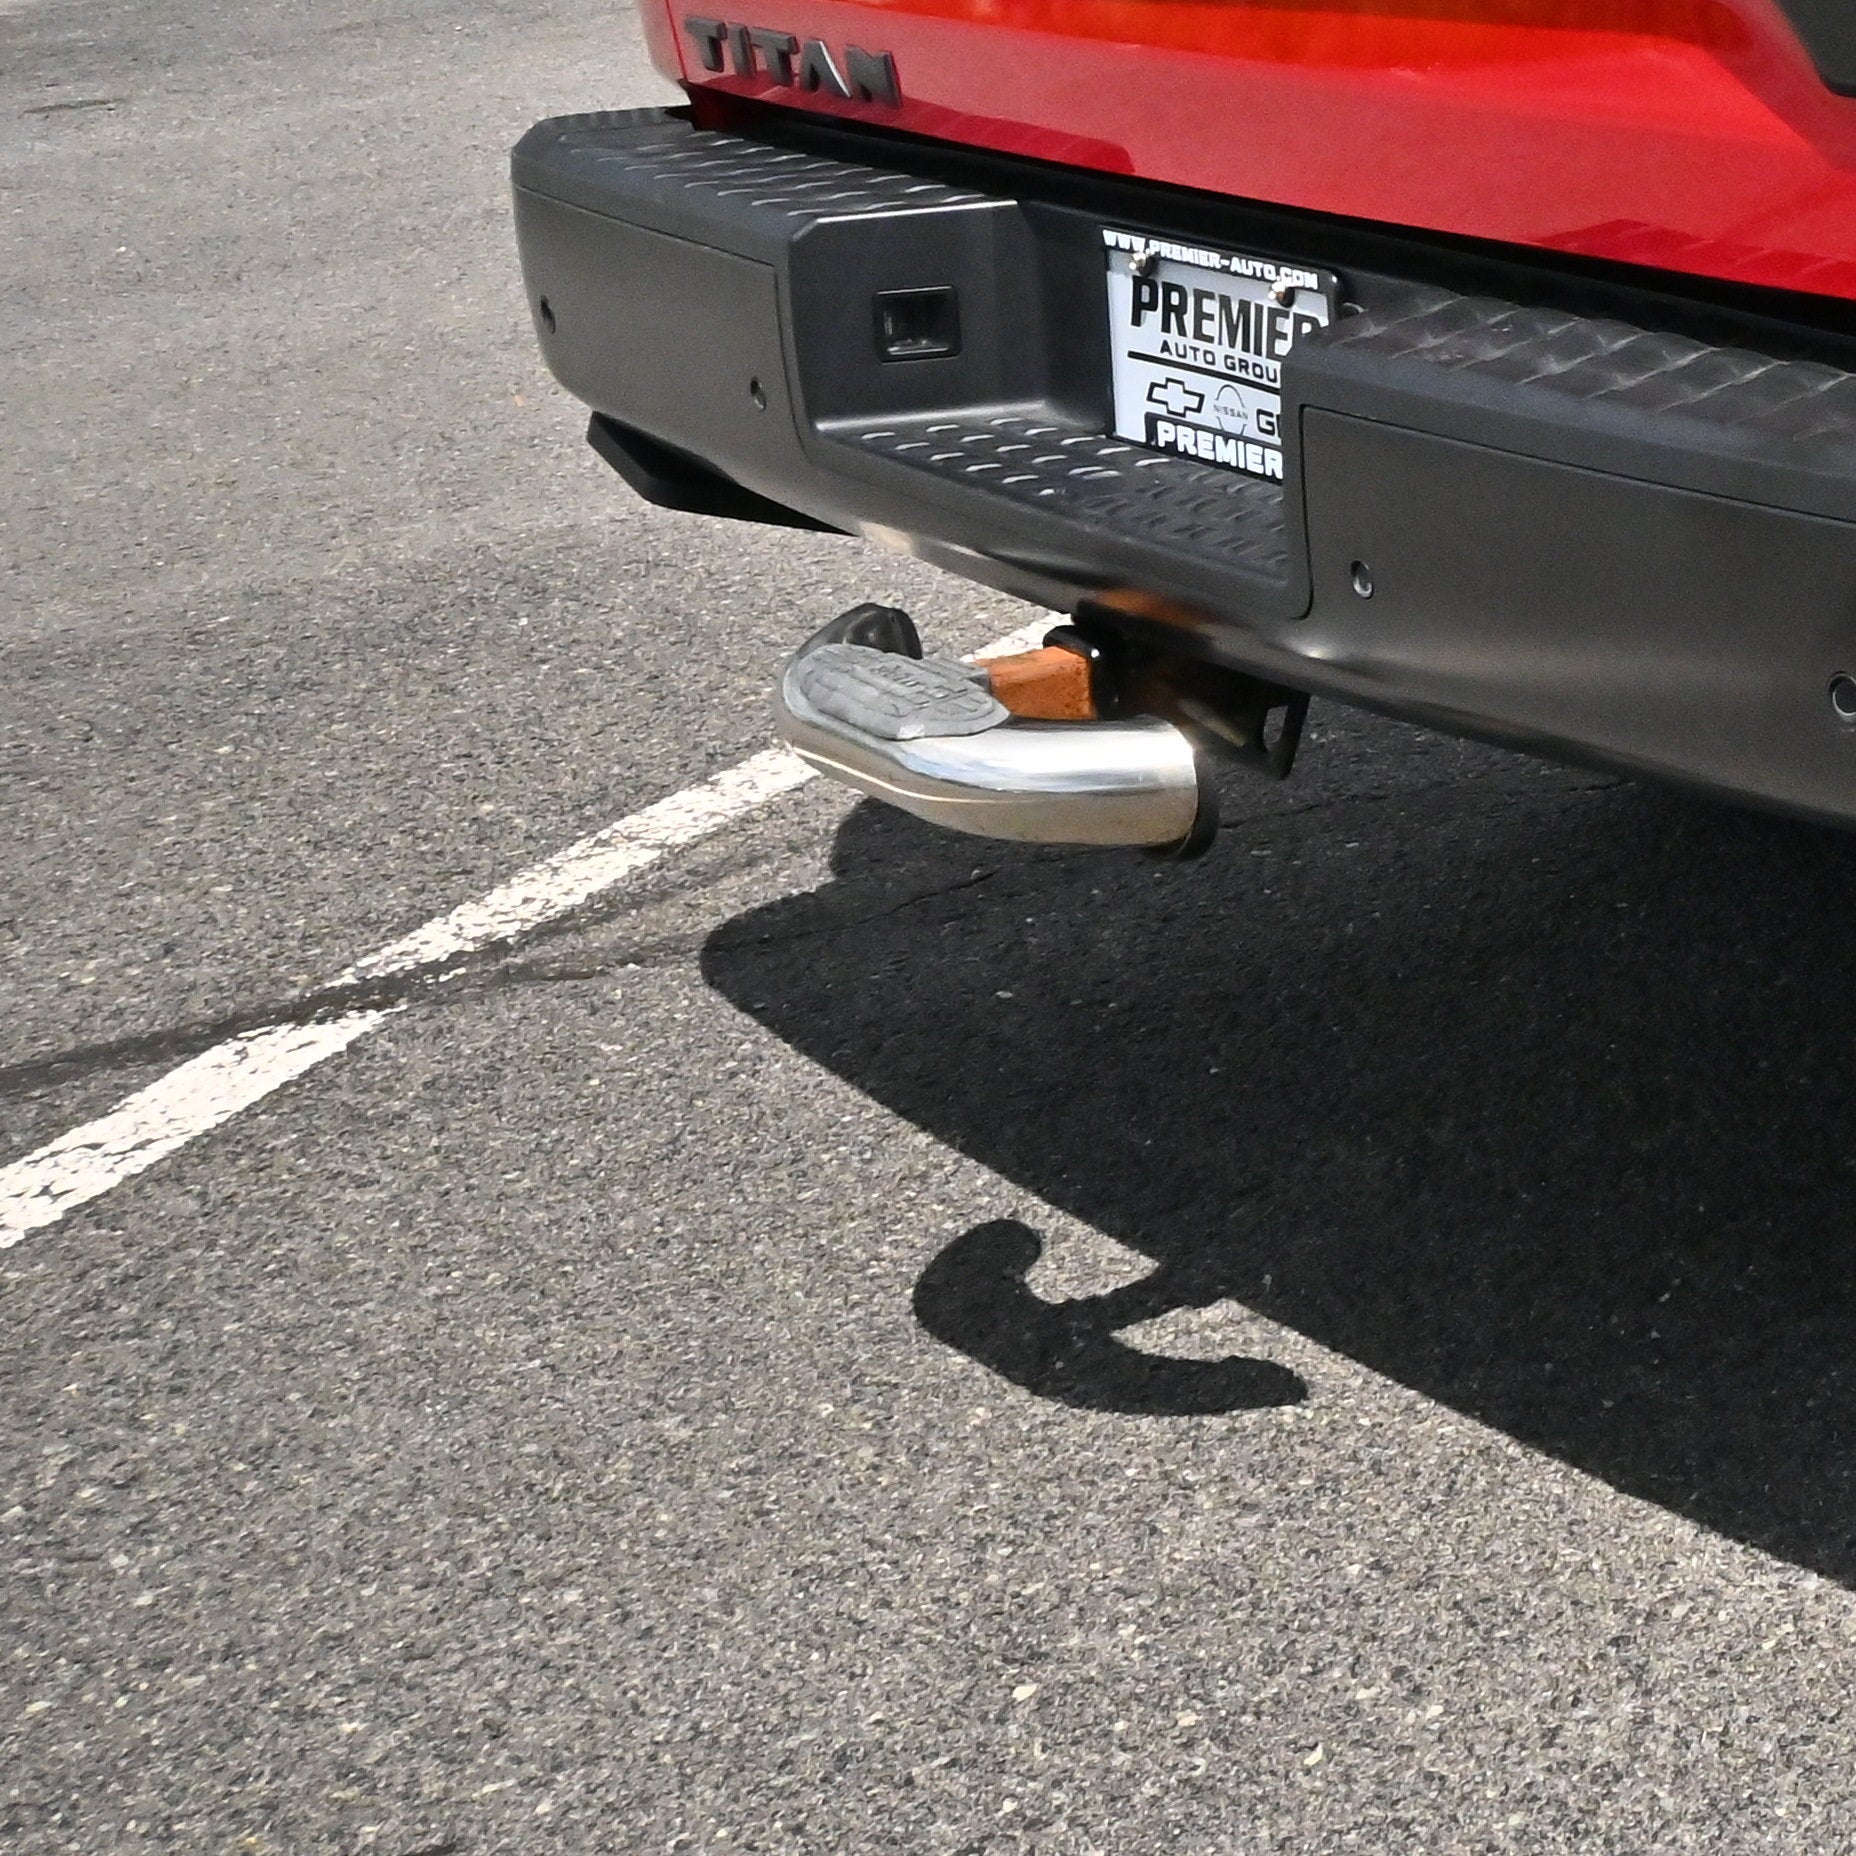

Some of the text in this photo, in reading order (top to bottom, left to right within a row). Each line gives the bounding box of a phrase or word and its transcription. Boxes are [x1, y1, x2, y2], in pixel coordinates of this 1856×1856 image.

[684, 15, 904, 108] TITAN
[1102, 229, 1319, 290] WWW.PREMIER-AUTO.COM
[1160, 339, 1279, 384] AUTO GROU
[1213, 404, 1248, 420] NISSAN
[1157, 421, 1283, 480] PREMIER
